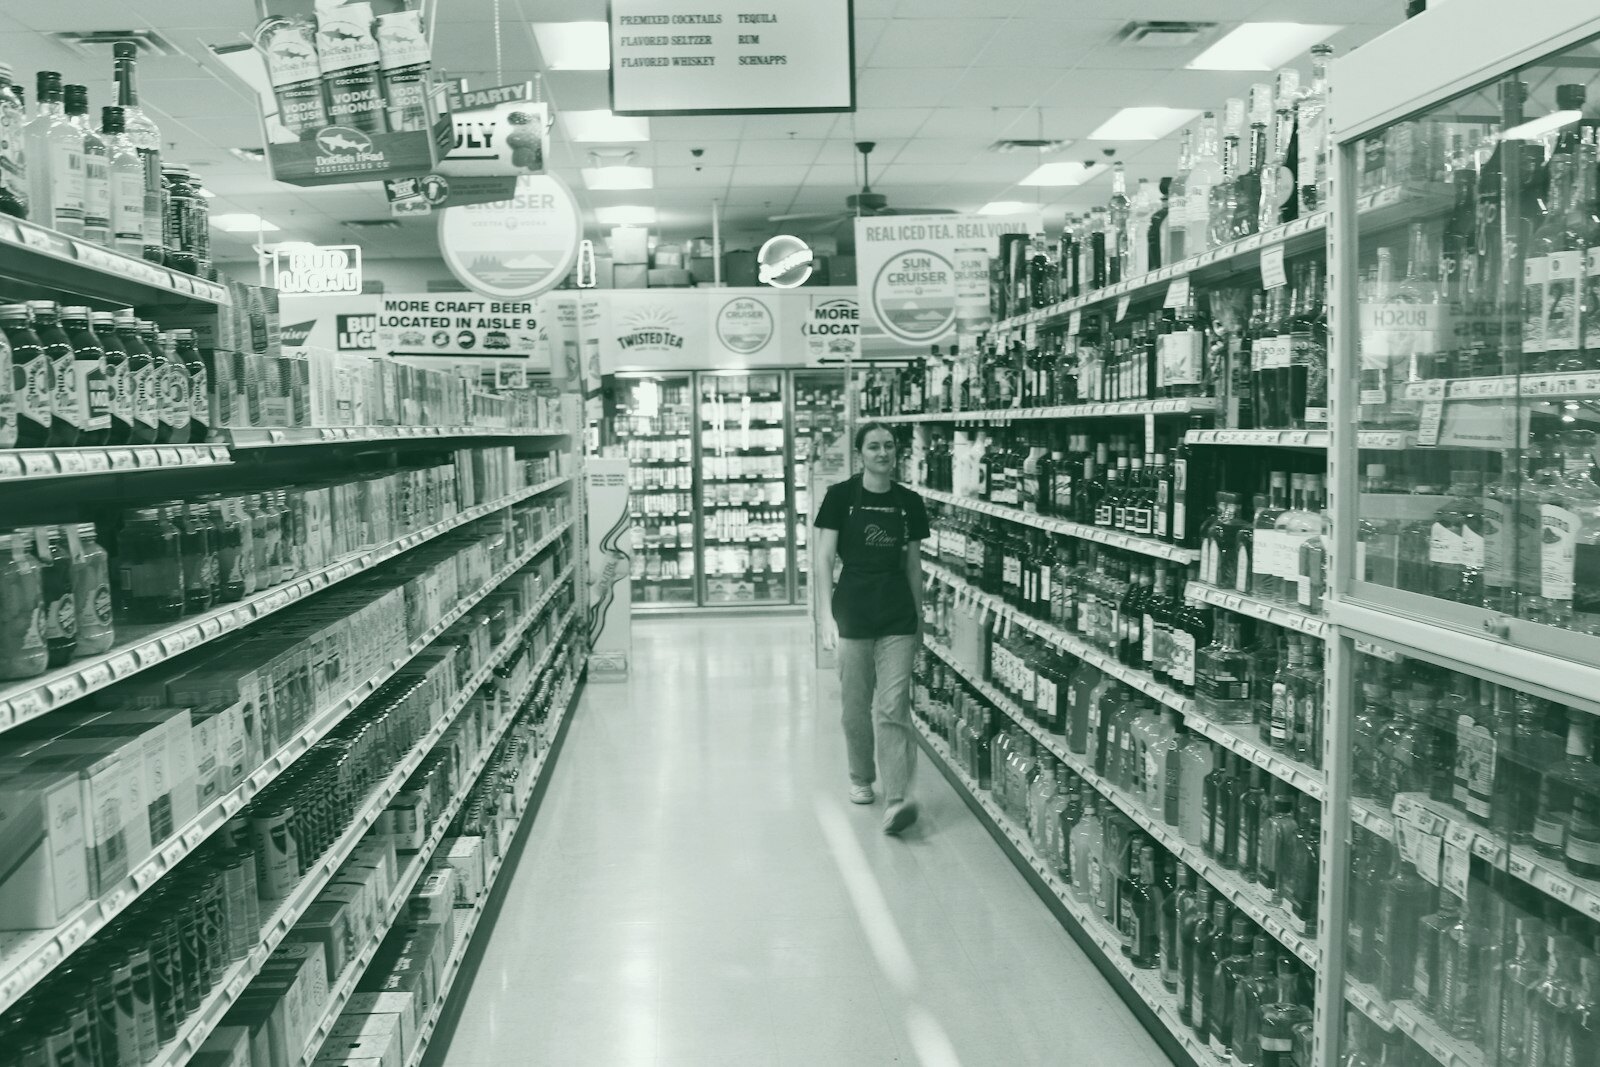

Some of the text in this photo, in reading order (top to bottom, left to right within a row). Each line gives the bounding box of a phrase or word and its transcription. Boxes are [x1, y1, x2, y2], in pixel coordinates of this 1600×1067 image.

[619, 14, 722, 25] PREMIXED COCKTAILS
[738, 14, 777, 24] TEQUILA
[620, 35, 712, 46] FLAVORED SELTZER
[738, 35, 759, 45] RUM
[621, 56, 715, 67] FLAVORED WHISKEY
[738, 56, 787, 66] SCHNAPPS
[333, 89, 379, 104] VODKA
[390, 85, 423, 98] VODK
[463, 84, 525, 107] PARTY
[283, 101, 323, 115] VODKA
[327, 98, 387, 116] LEMONADE
[285, 110, 324, 123] CRUSH
[314, 163, 373, 174] DISTILLING
[866, 226, 897, 242] REAL
[899, 225, 926, 241] ICED
[927, 225, 954, 240] TEA.
[956, 223, 987, 239] REAL
[902, 258, 932, 269] SUN
[960, 260, 982, 269] SUN
[887, 272, 947, 284] CRUISER
[385, 300, 532, 314] MORE CRAFT BEER
[725, 311, 764, 319] CRUISER
[815, 308, 860, 320] MORE
[379, 316, 537, 330] LOCATED IN AISLE 9
[339, 333, 376, 349] LIG
[616, 331, 684, 350] TWISTED TEA
